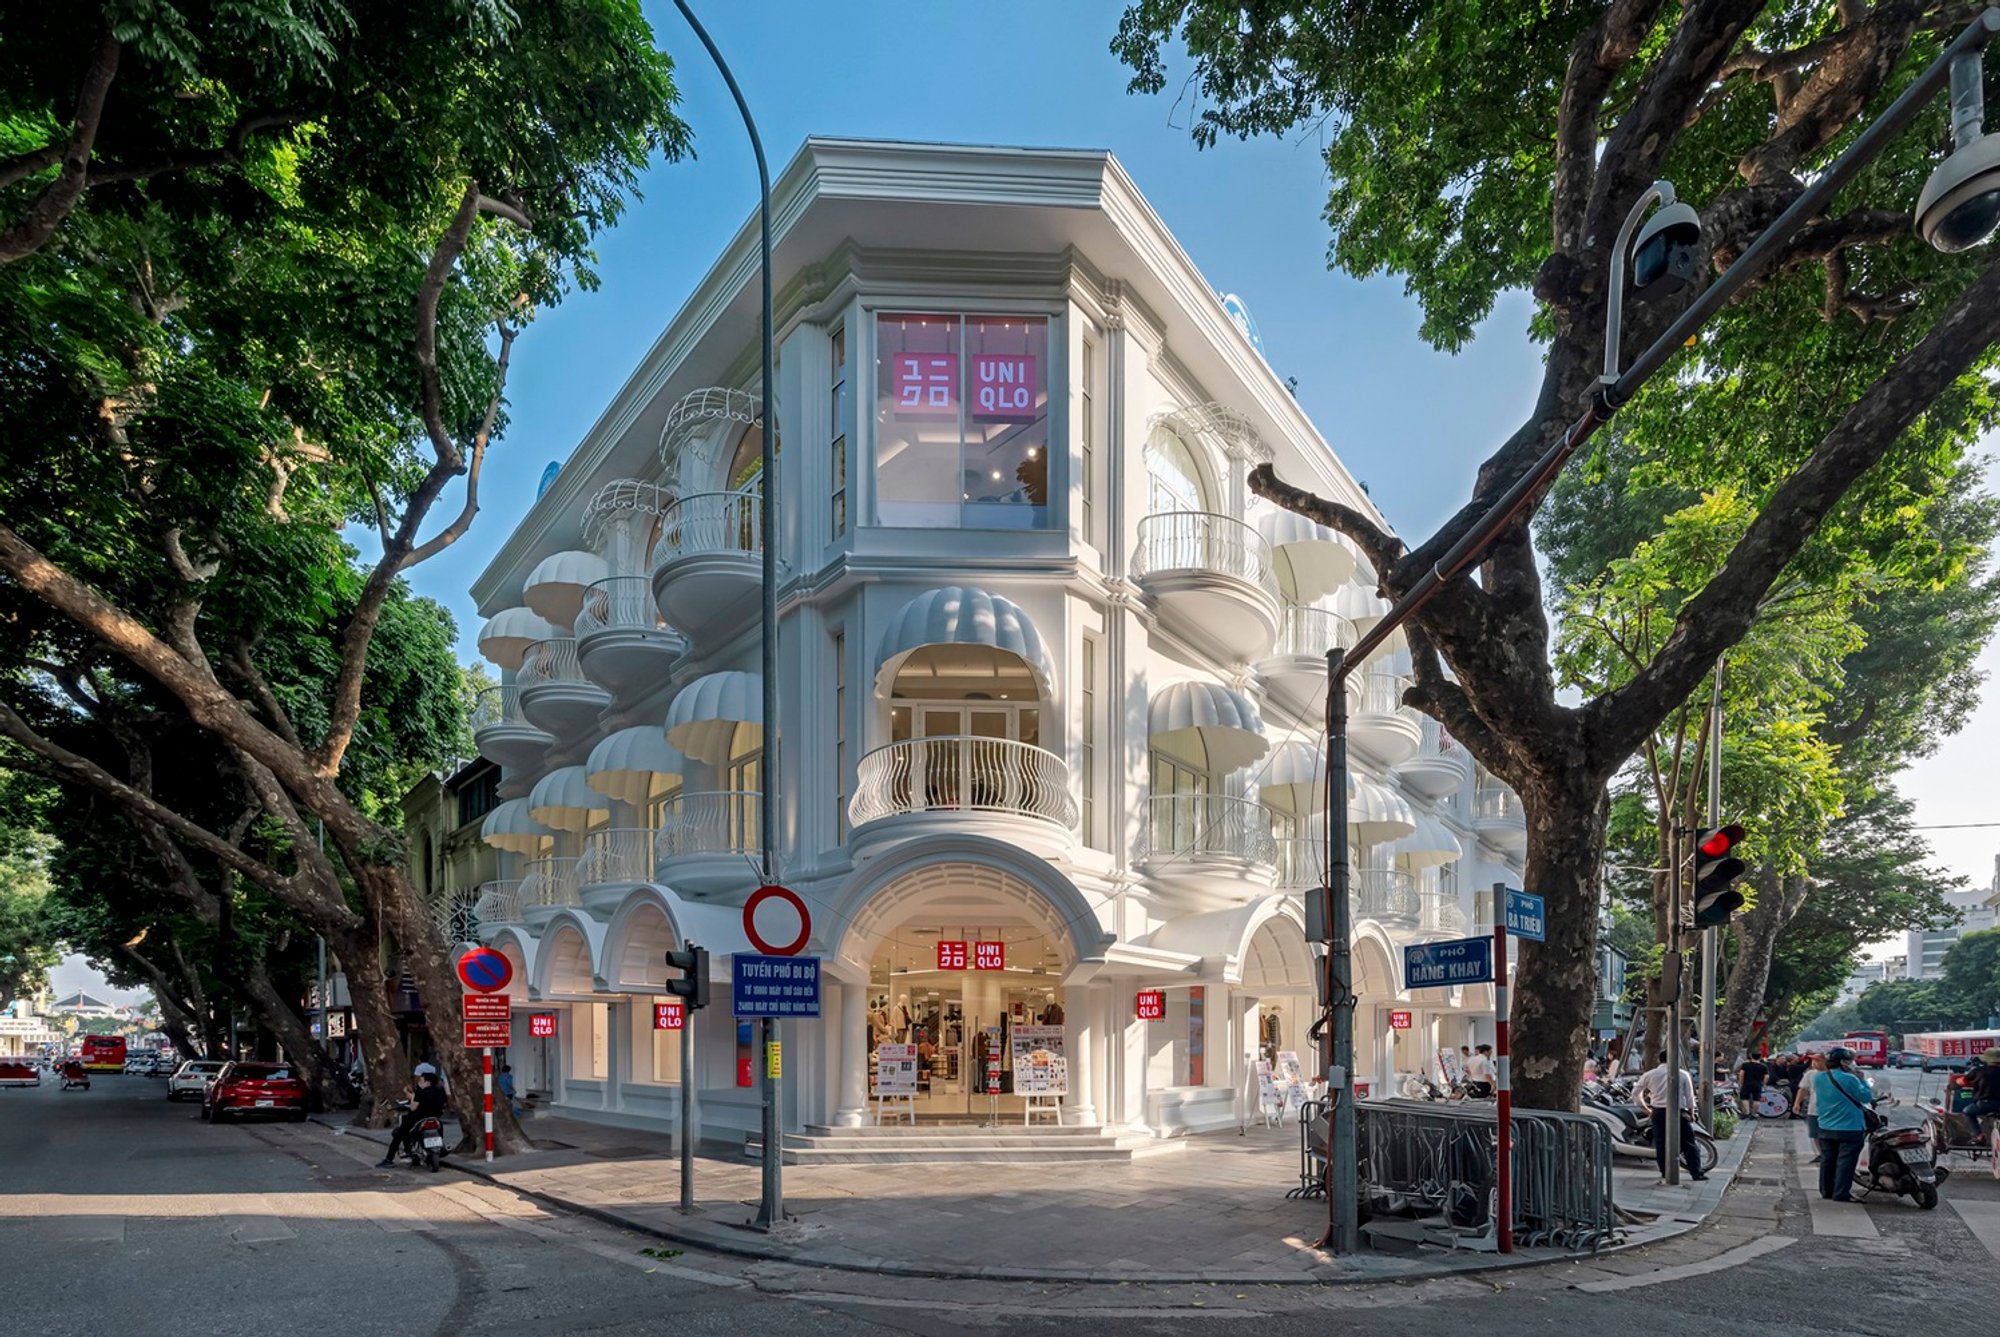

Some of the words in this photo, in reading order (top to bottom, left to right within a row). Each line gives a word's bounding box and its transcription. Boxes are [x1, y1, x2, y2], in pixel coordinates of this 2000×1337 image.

[902, 359, 949, 381] ユニ
[979, 361, 1025, 384] UNI
[900, 385, 949, 407] クロ
[979, 386, 1029, 411] QLO
[1521, 900, 1534, 910] PHỐ
[1508, 911, 1519, 929] BÀ
[1519, 914, 1541, 935] TRIỆU
[977, 945, 999, 956] UNI
[1439, 946, 1466, 957] PHỐ
[977, 956, 1002, 968] QLO
[742, 960, 772, 978] TUYẾN
[773, 961, 792, 978] PHỐ
[803, 963, 816, 982] BỘ
[1412, 962, 1445, 982] HÀNG
[1449, 961, 1481, 978] KHAY
[1139, 995, 1158, 1005] UNI
[660, 1006, 680, 1016] UNI
[1139, 1006, 1159, 1017] QLO
[533, 1017, 551, 1026] UNI
[660, 1017, 682, 1028] QLO
[533, 1026, 552, 1036] QLO
[1972, 1039, 1991, 1047] UNI
